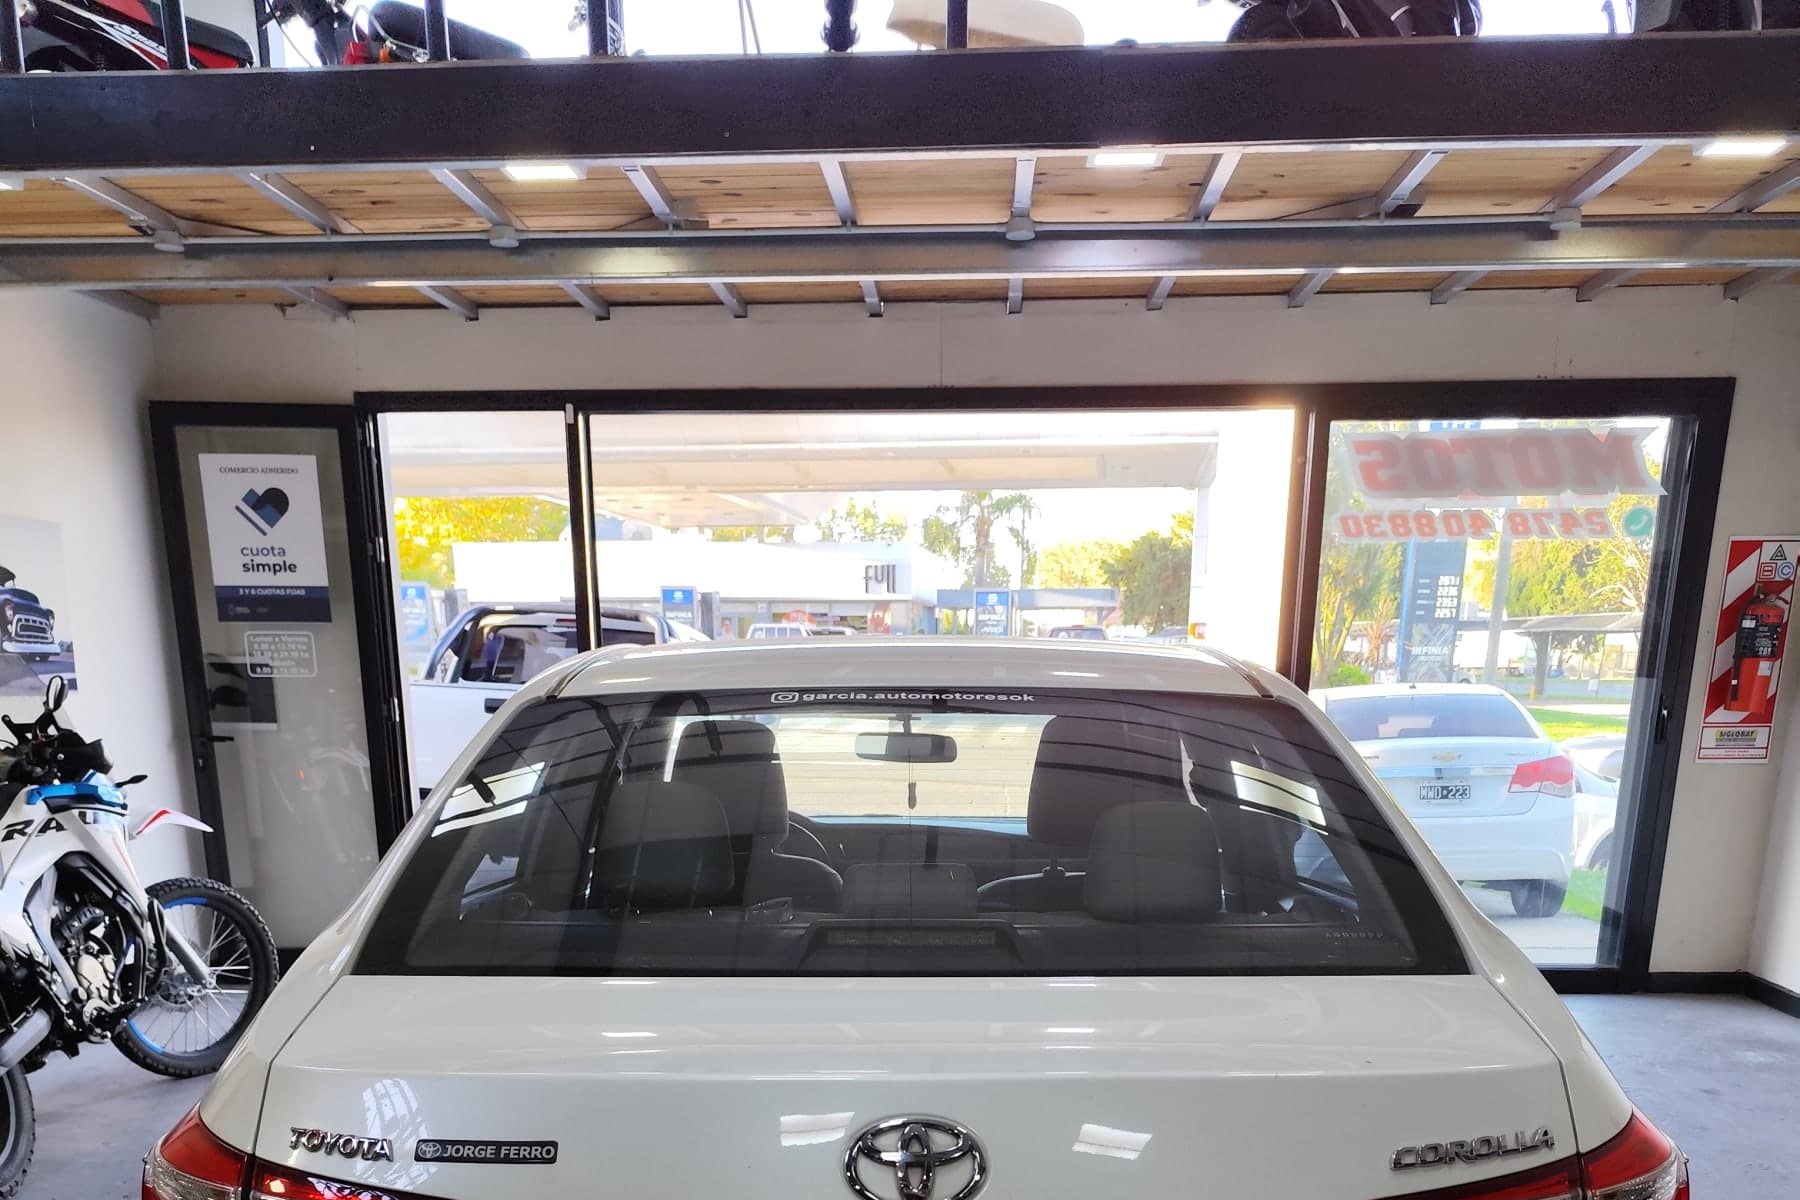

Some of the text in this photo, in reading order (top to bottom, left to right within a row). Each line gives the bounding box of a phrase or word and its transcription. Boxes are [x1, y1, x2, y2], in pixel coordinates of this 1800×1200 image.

[240, 545, 286, 557] cuota
[242, 559, 297, 576] simple
[863, 564, 896, 594] full
[802, 690, 1036, 702] garcia.automotoresok
[290, 1126, 394, 1162] TOYOTA
[442, 1144, 555, 1159] JORGE FERRO
[1390, 1126, 1555, 1170] COROLLA
